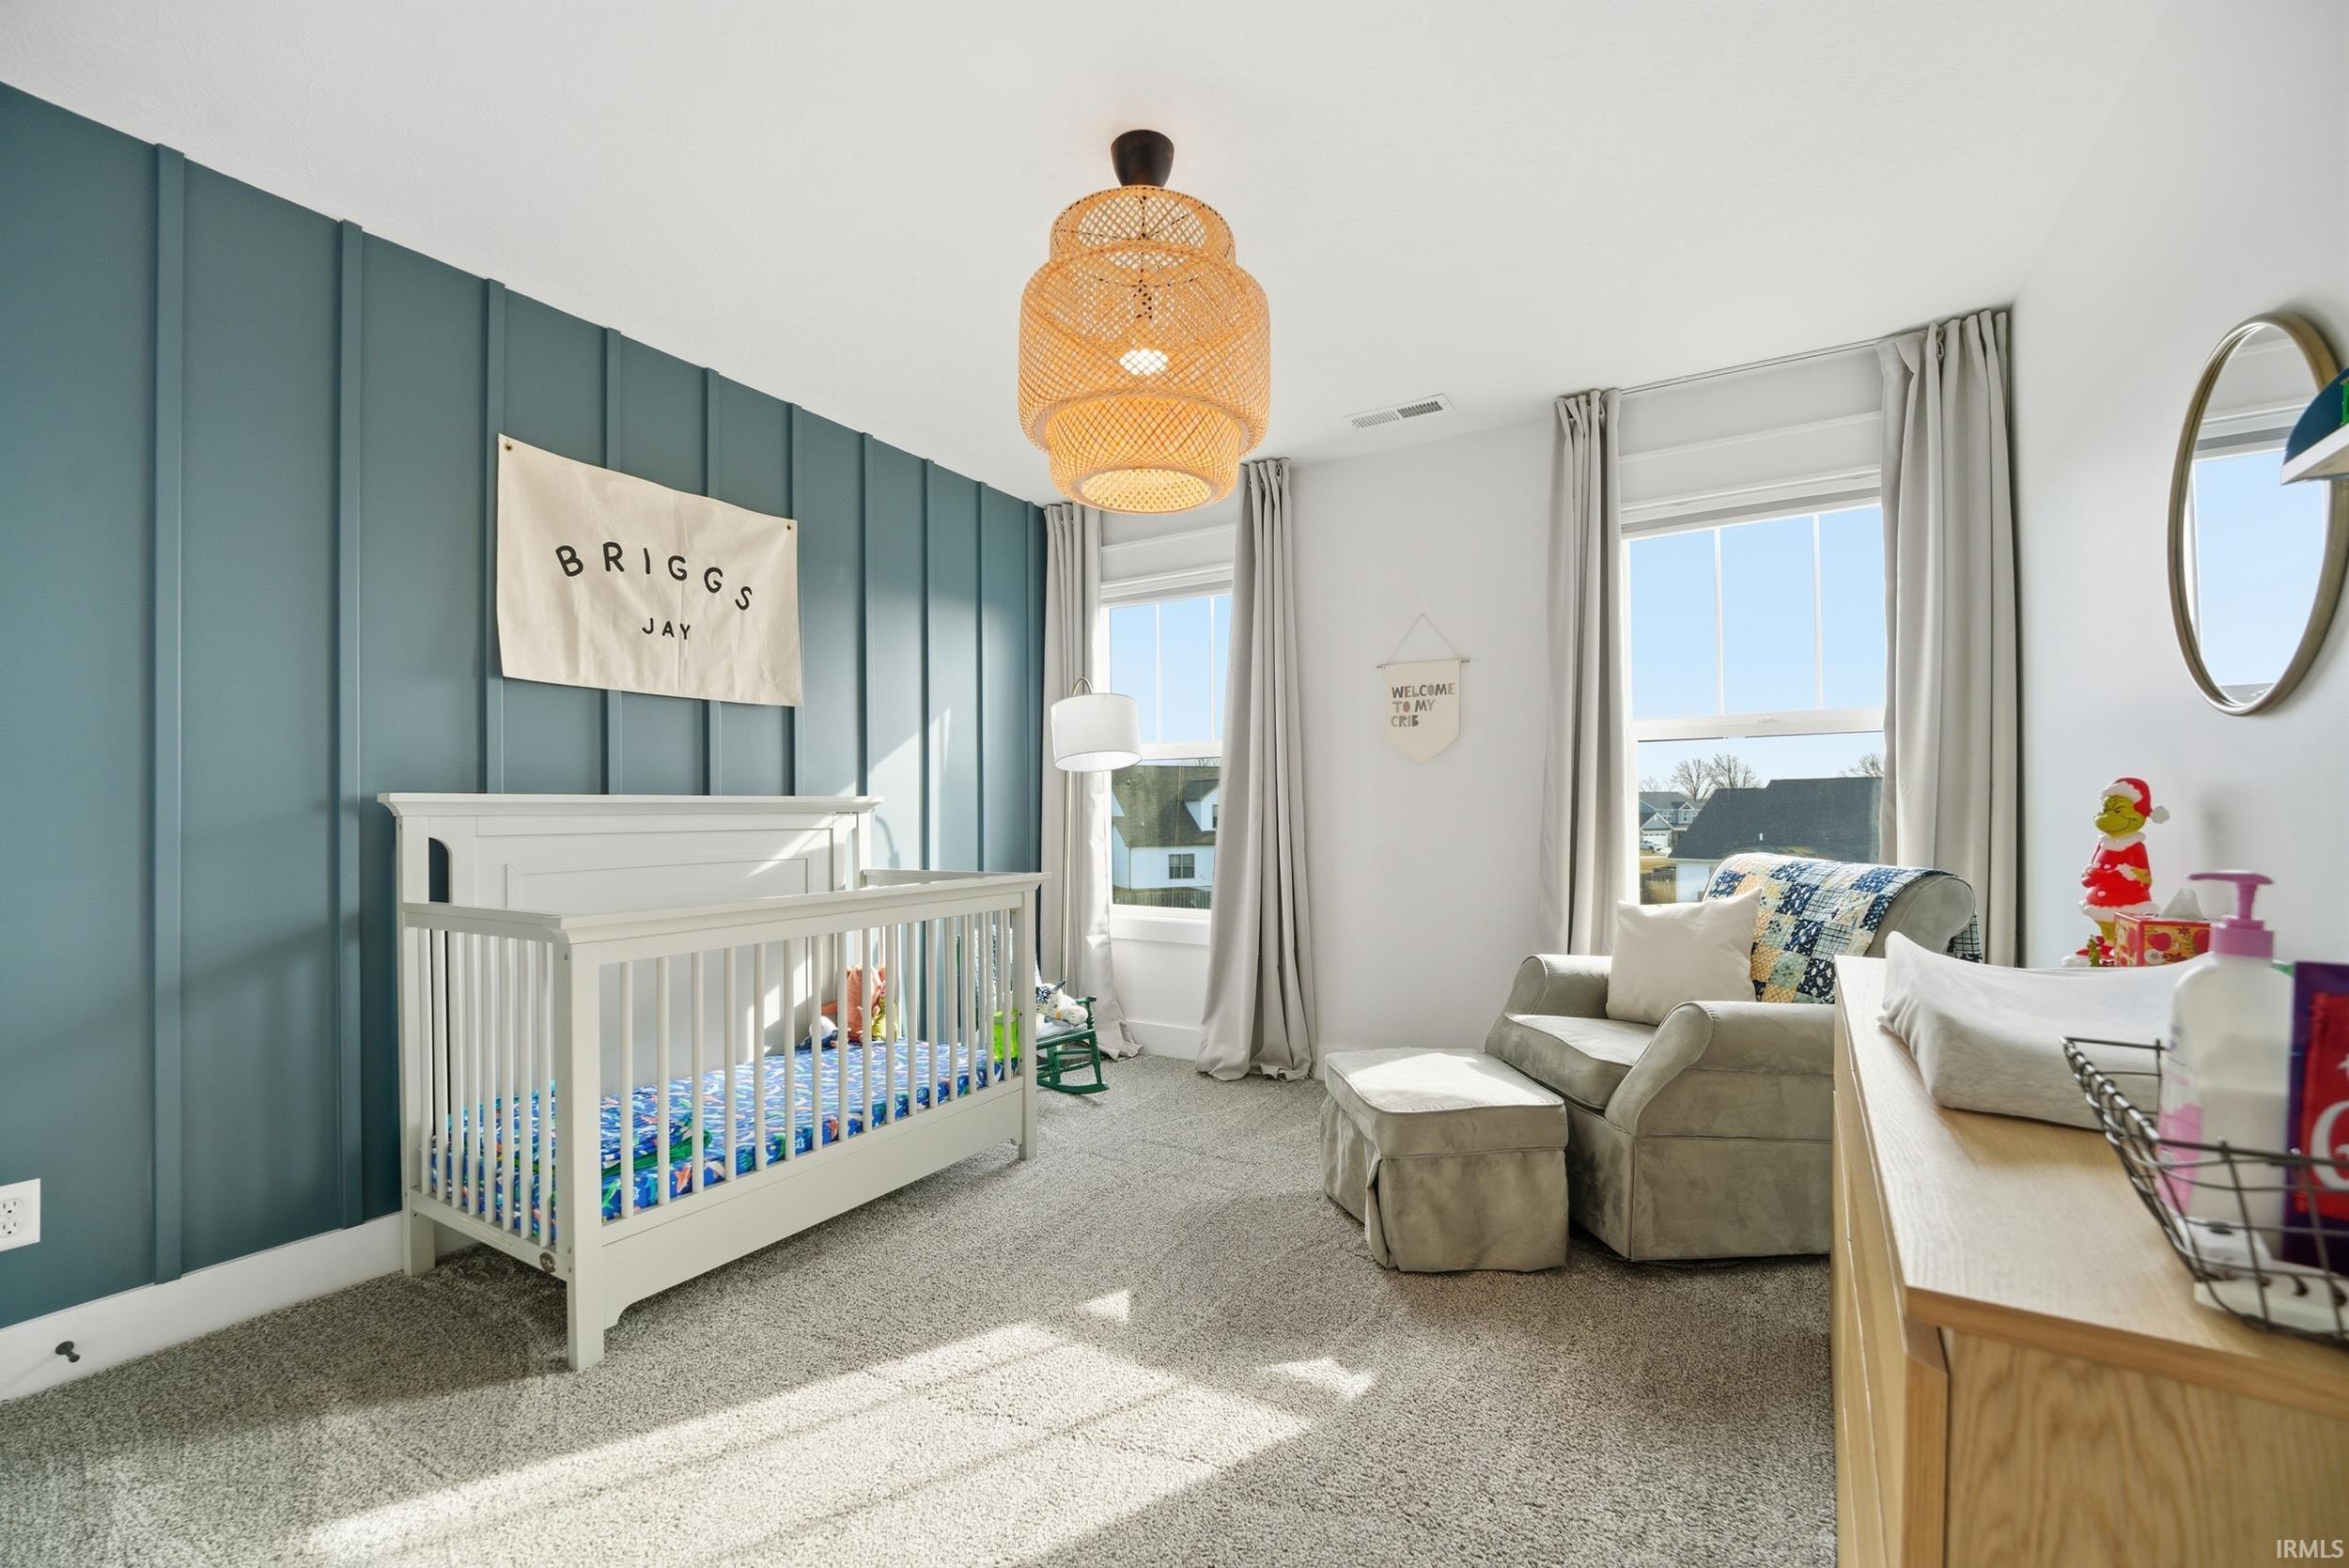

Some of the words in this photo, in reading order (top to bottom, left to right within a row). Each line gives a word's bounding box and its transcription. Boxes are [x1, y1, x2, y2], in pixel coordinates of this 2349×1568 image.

[555, 541, 753, 611] BRIGGS
[642, 617, 691, 640] JAY
[1391, 683, 1456, 698] WELCOME
[1392, 701, 1410, 713] TO
[1414, 699, 1436, 712] MY
[1391, 715, 1420, 727] CRIB
